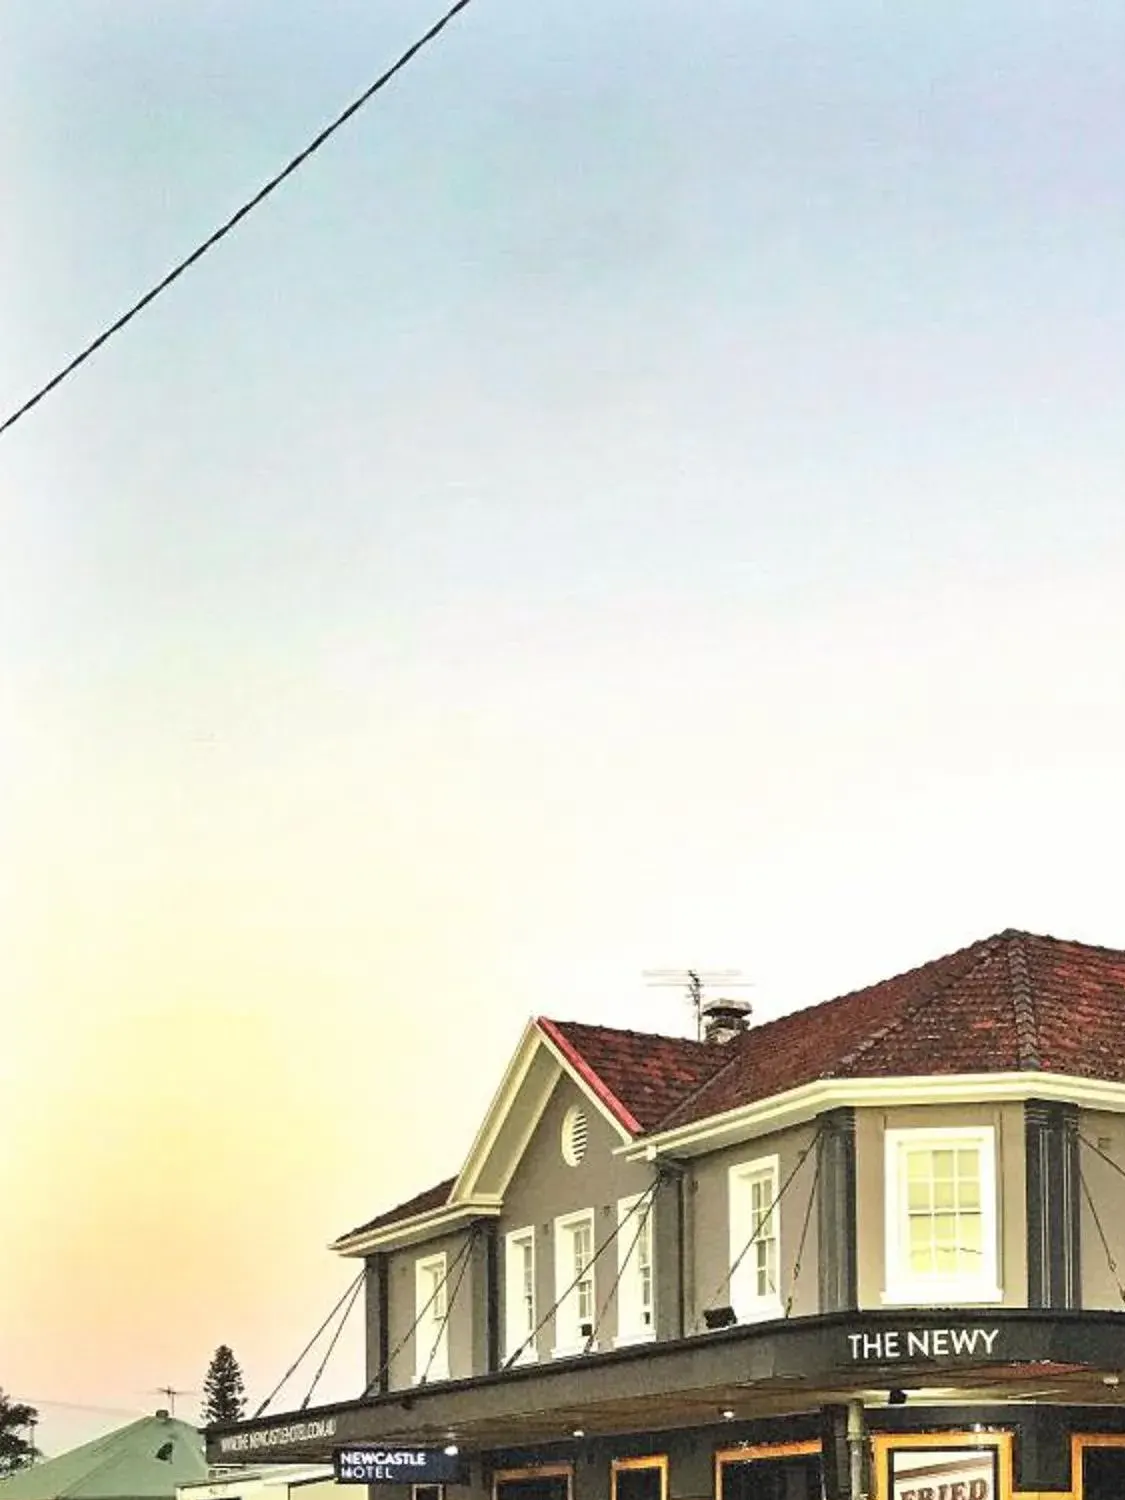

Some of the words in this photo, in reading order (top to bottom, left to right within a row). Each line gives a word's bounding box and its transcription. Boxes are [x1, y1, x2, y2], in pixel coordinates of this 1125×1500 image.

[847, 1331, 901, 1360] THE
[907, 1328, 1000, 1357] NEWY
[340, 1451, 427, 1466] NEWCASTLE
[340, 1465, 394, 1479] HOTEL
